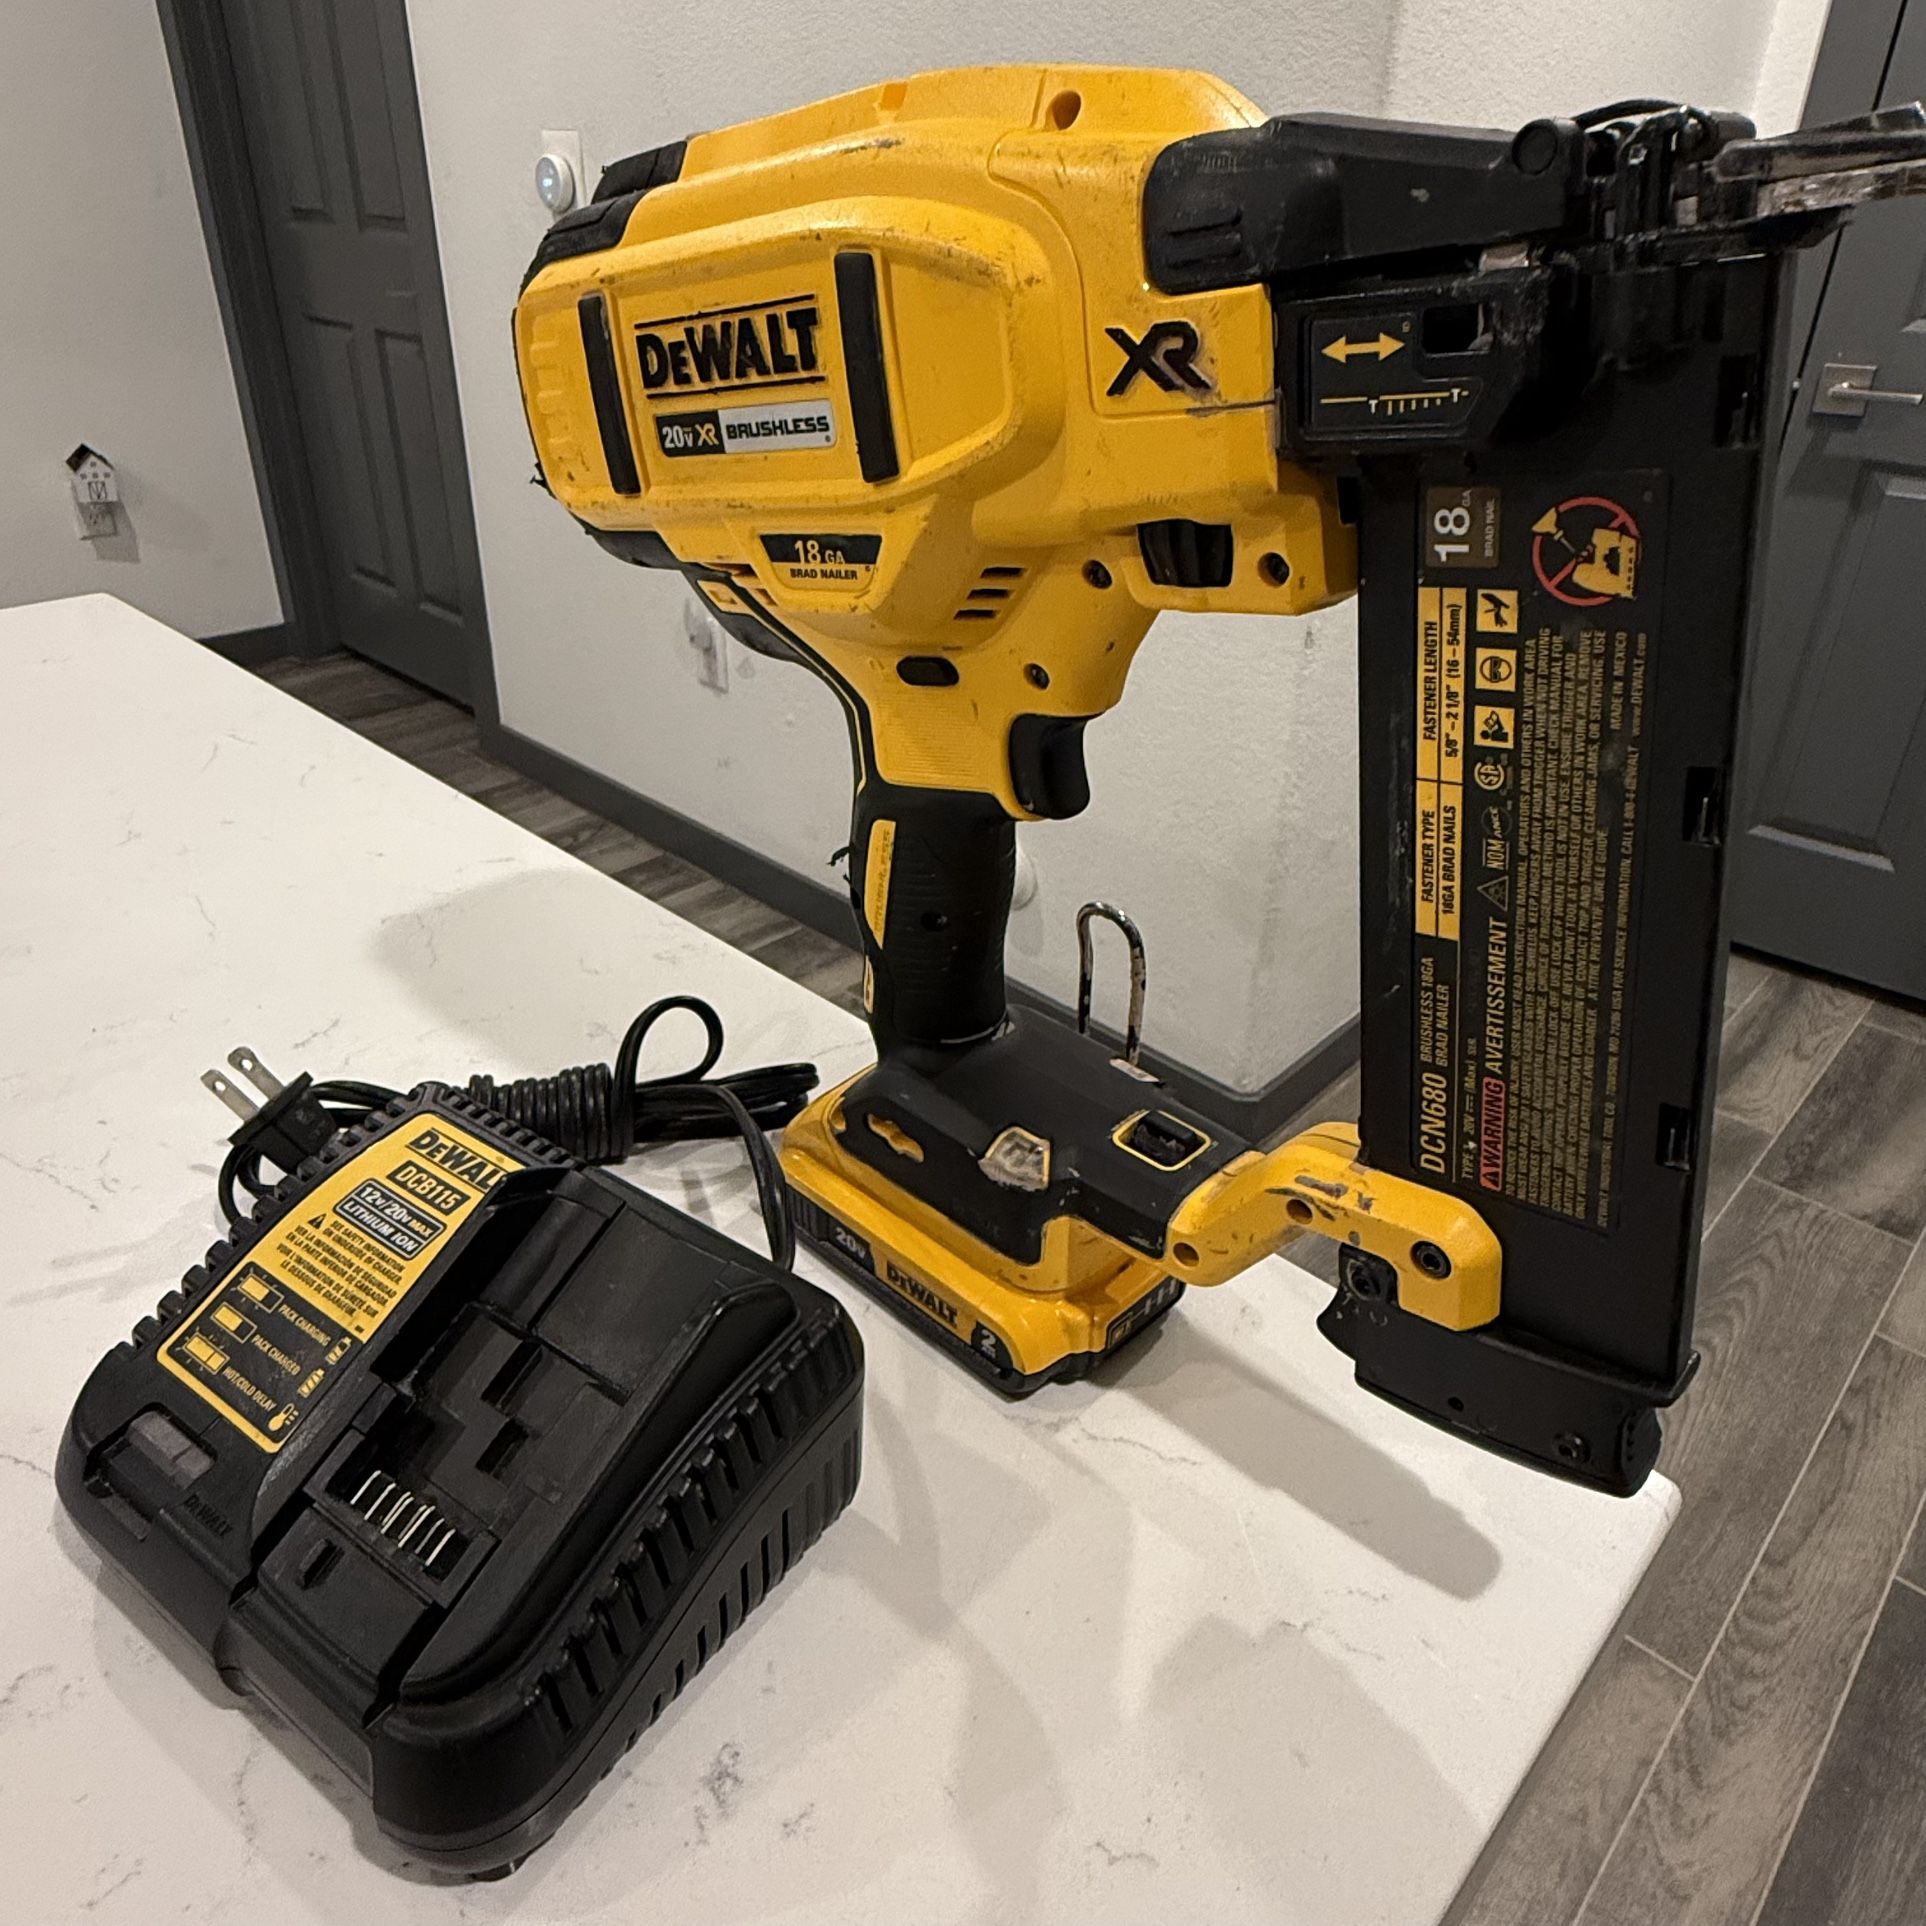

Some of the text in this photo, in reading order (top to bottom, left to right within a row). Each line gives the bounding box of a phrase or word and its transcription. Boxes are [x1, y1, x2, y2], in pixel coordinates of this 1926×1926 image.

[636, 307, 817, 389] DEWALT
[1104, 321, 1213, 397] XR
[695, 423, 719, 446] XR
[726, 416, 830, 440] BRUSHLESS
[1433, 506, 1470, 562] 18
[1484, 498, 1495, 557] BRAD NAIL
[795, 540, 845, 564] 18 GA
[790, 568, 858, 580] BRAD NAILER
[1444, 603, 1462, 646] 54mm)
[1524, 638, 1536, 669] AREA
[1537, 627, 1550, 675] DRIVING
[1551, 634, 1564, 657] FOR
[1577, 630, 1592, 680] REMOVE
[1593, 630, 1606, 653] USE
[1422, 620, 1438, 741] FASTENER LENGTH
[1444, 658, 1461, 678] (16
[1563, 652, 1576, 678] AND
[1609, 631, 1627, 730] MADE IN MEXICO
[1523, 671, 1535, 707] WORK
[1536, 677, 1548, 701] NOT
[1549, 660, 1562, 710] MANUAL
[1445, 711, 1458, 720] 2
[1522, 709, 1533, 721] IN
[1561, 679, 1575, 728] TRIGGER
[1534, 703, 1547, 738] WHEN
[1547, 713, 1560, 748] CHECK
[1573, 718, 1587, 753] WORK
[1588, 722, 1600, 738] OR
[1521, 723, 1533, 766] OTHERS
[1559, 731, 1572, 775] ENSURE
[1586, 741, 1599, 777] JAMS,
[1532, 740, 1546, 786] TRIGGER
[1573, 754, 1585, 768] IN
[1520, 768, 1531, 792] AND
[1570, 769, 1584, 813] OTHERS
[1531, 787, 1544, 818] FROM
[1557, 803, 1569, 817] IN
[1583, 778, 1597, 833] CLEARING
[1517, 794, 1530, 855] OPERATORS
[1530, 819, 1542, 852] AWAY
[1544, 819, 1555, 830] IS
[1556, 819, 1568, 842] NOT
[1569, 814, 1582, 830] OR
[1420, 809, 1434, 903] FASTENER TYPE
[1486, 837, 1505, 870] NOM
[1542, 831, 1555, 877] METHOD
[1556, 842, 1567, 854] IS
[1567, 832, 1581, 884] YOURSELF
[1620, 829, 1633, 855] CALL
[1442, 804, 1456, 916] 18GA BRAD NAILS
[1528, 853, 1541, 897] FINGERS
[1555, 855, 1567, 883] TOOL
[1594, 865, 1606, 877] LE
[1553, 883, 1565, 915] WHEN
[1566, 883, 1578, 900] AT
[1579, 884, 1591, 908] AND
[1593, 877, 1605, 902] LIRE
[1527, 897, 1539, 923] KEEP
[1539, 878, 1553, 939] TRIGGERING
[1565, 901, 1577, 927] TOOL
[1577, 909, 1590, 933] TRIP
[1513, 907, 1526, 973] INSTRUCTION
[1552, 918, 1563, 938] OFF
[1538, 941, 1550, 955] OF
[1550, 939, 1562, 966] LOCK
[1563, 929, 1575, 961] POINT
[1575, 935, 1588, 982] CONTACT
[1613, 929, 1627, 969] SERVICE
[1512, 973, 1523, 1001] READ
[1537, 955, 1549, 993] CHOICE
[1549, 967, 1561, 987] USE
[1561, 962, 1574, 996] NEVER
[1588, 962, 1600, 990] TITRE
[1612, 969, 1624, 990] FOR
[1574, 986, 1585, 999] OF
[1587, 990, 1599, 1001] A
[1420, 955, 1434, 1063] BRUSHLESS 18GA
[1435, 982, 1449, 1067] BRAD NAILER
[1511, 1002, 1522, 1030] MUST
[1482, 915, 1508, 1172] WARNING AVERTISSEMENT
[1510, 1030, 1521, 1057] USER
[1508, 1093, 1518, 1107] OF
[1420, 1069, 1447, 1175] DCN680
[1507, 1107, 1518, 1129] RISK
[1506, 1129, 1517, 1148] THE
[408, 1129, 505, 1191] DEWAL
[1461, 1150, 1474, 1181] TYPE
[1505, 1147, 1516, 1184] REDUCE
[393, 1164, 462, 1210] DCB115
[1504, 1182, 1515, 1197] TO
[341, 1200, 418, 1252] LITHIUM ION
[406, 1218, 434, 1238] MAX
[276, 1303, 332, 1347] PACK CHARGING
[981, 1329, 996, 1345] 2
[250, 1333, 302, 1377] PACK CHARGED
[221, 1365, 277, 1413] HOT/COLD DELAY
